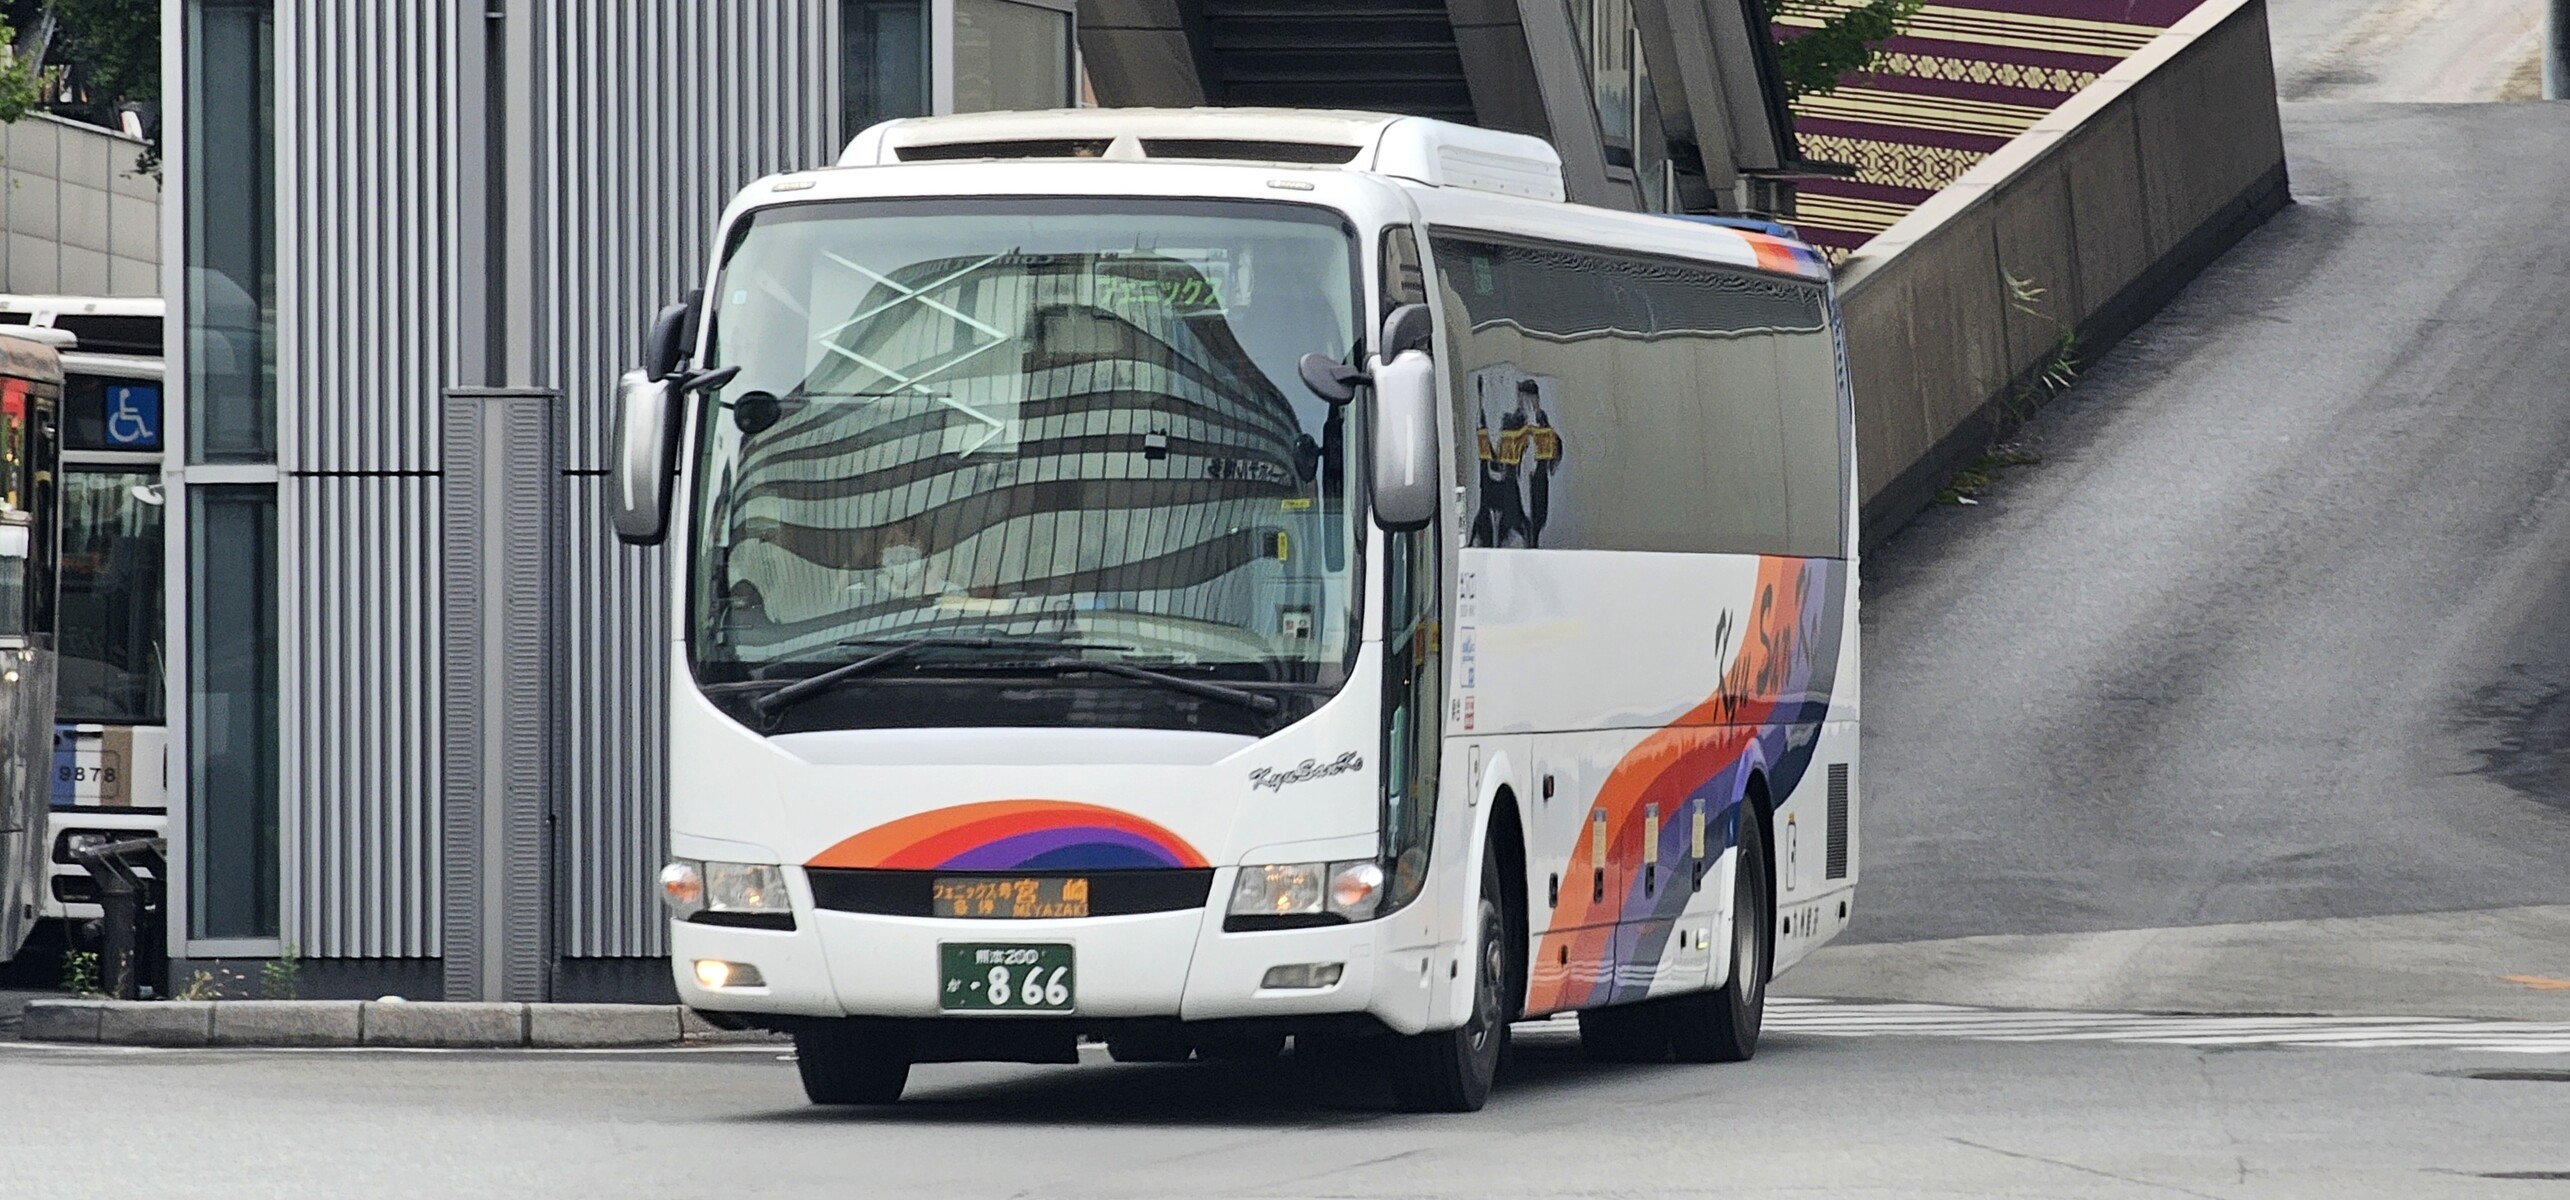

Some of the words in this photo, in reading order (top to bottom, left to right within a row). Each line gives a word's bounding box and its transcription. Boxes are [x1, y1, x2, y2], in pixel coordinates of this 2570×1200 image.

[1098, 276, 1223, 305] フェニックス
[58, 766, 117, 782] 9878
[1013, 902, 1089, 917] MIYAZAKI
